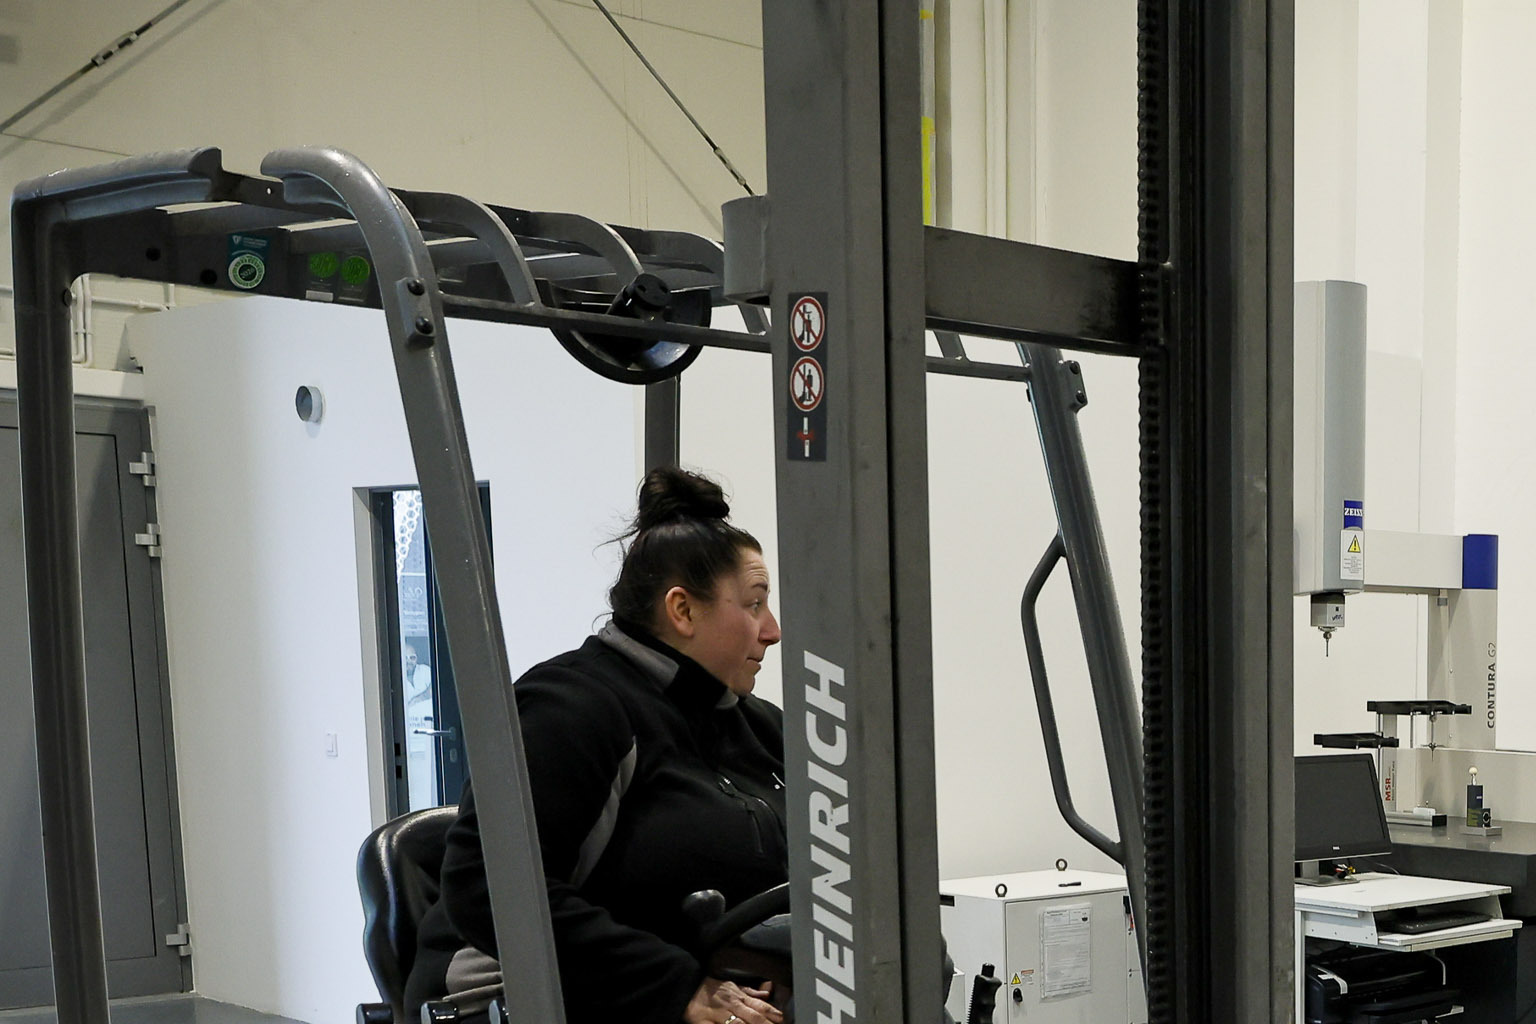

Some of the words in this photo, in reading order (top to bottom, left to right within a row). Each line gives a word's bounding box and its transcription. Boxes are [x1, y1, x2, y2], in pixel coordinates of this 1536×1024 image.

[1344, 508, 1363, 516] ZEISS
[1487, 642, 1496, 658] G2
[1487, 662, 1496, 729] CONTURA
